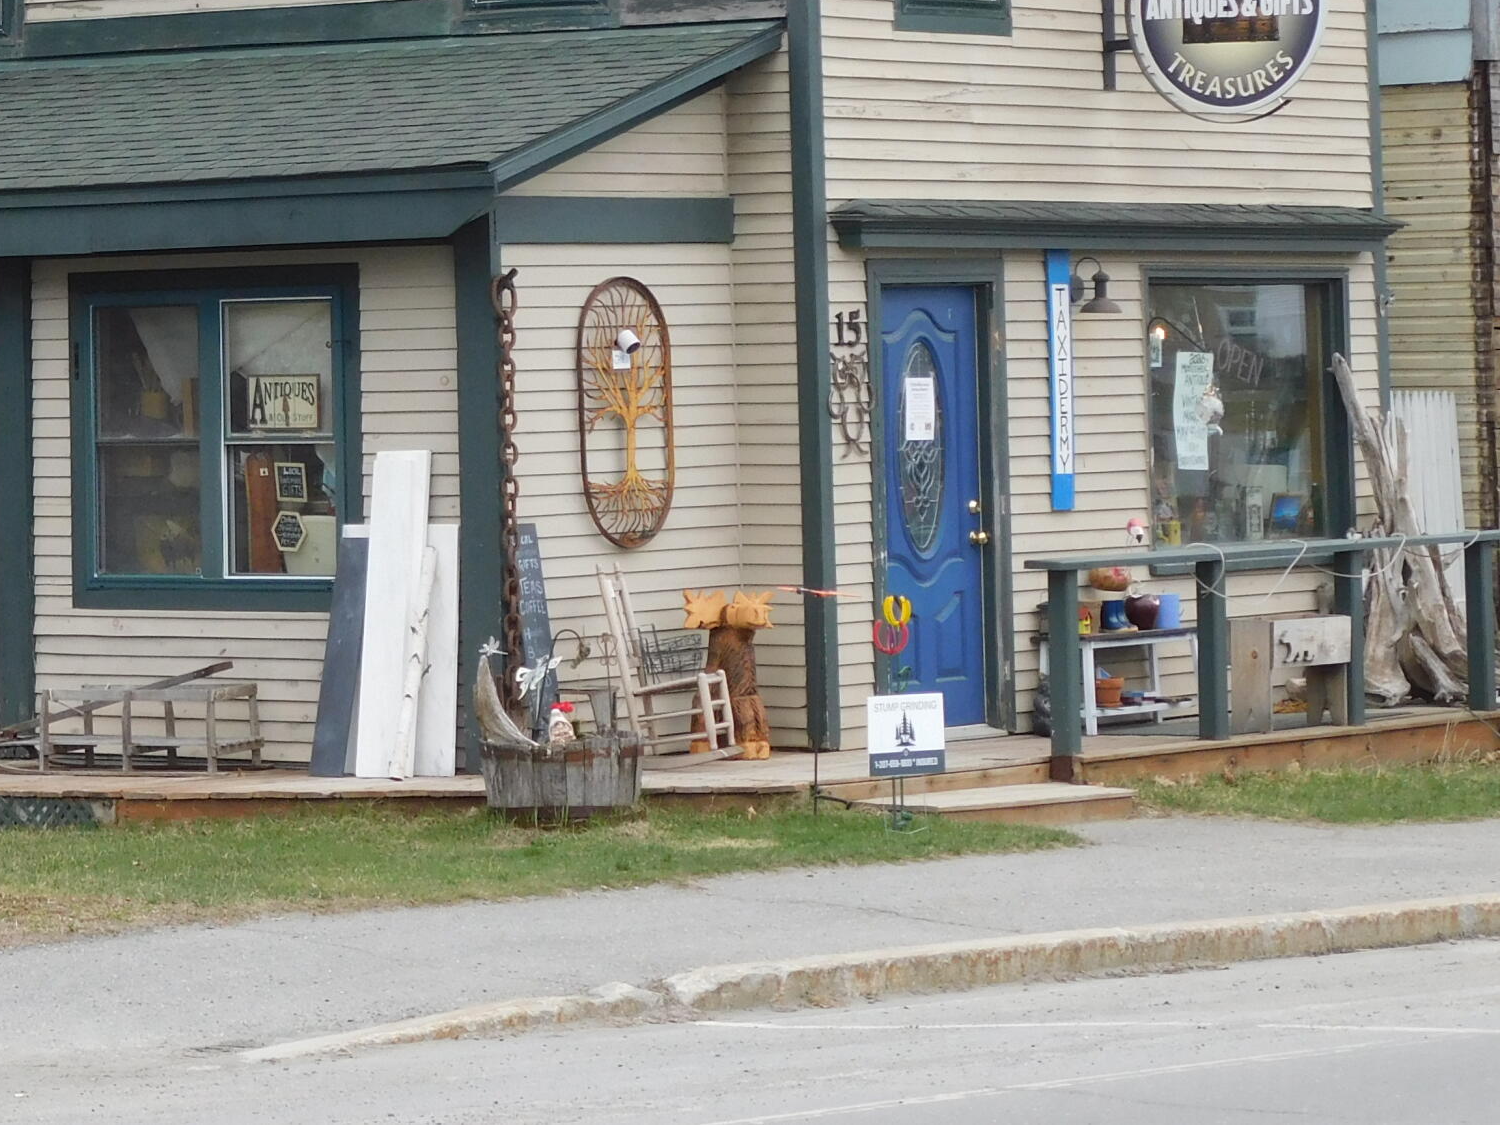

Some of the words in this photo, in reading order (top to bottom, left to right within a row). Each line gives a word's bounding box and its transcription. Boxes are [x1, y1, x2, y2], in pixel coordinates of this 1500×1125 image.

[1168, 50, 1294, 99] TREASURES
[834, 309, 862, 347] 15
[1055, 288, 1070, 473] TAXIDERMY
[1218, 339, 1264, 386] OPEN
[248, 377, 315, 425] ANTIQUES
[519, 577, 544, 595] TEAS
[874, 702, 899, 713] STUMP
